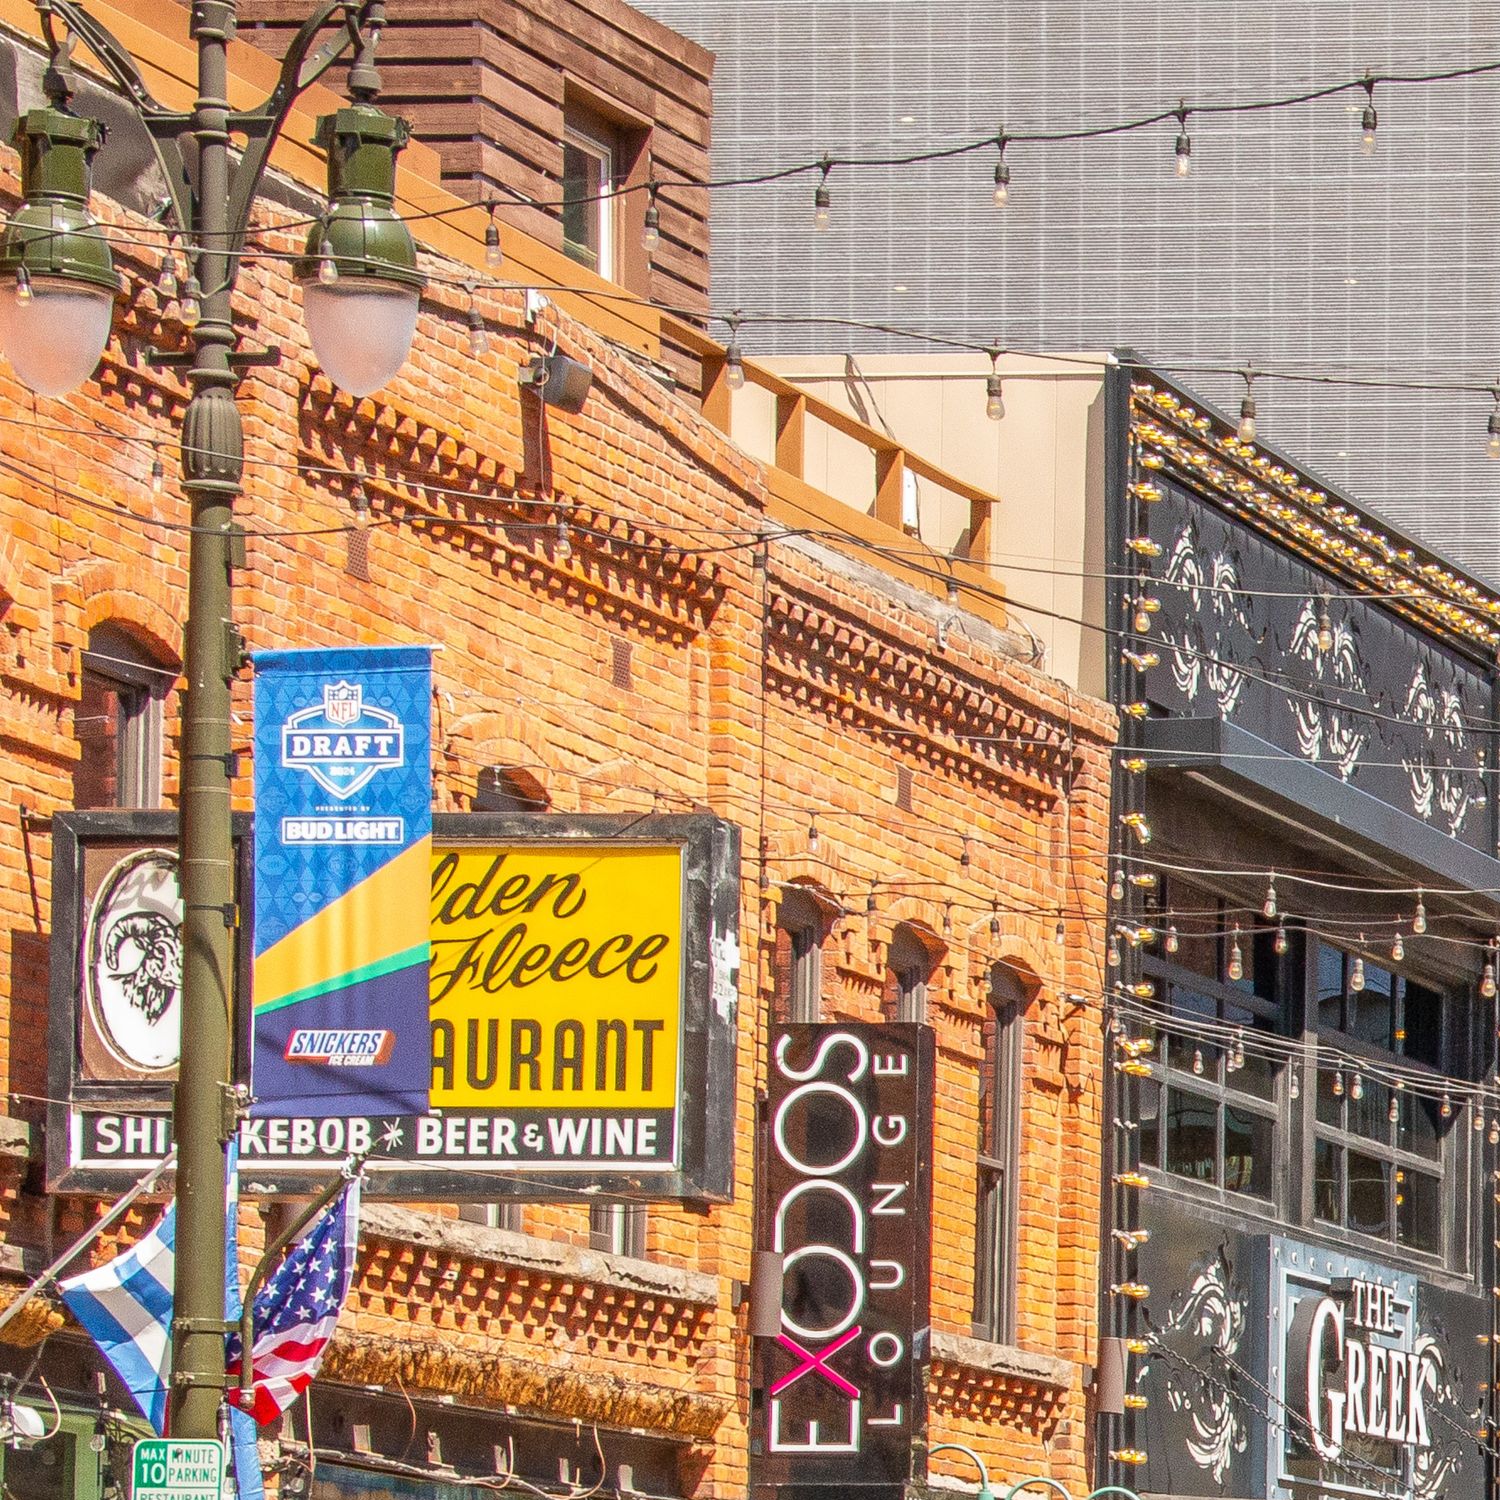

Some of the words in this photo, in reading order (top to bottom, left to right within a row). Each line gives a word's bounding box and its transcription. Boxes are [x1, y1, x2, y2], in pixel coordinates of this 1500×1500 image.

[331, 702, 356, 721] NFL
[292, 735, 393, 757] DRAFT
[286, 821, 333, 840] BUD
[335, 821, 399, 840] LIGHT
[431, 852, 587, 925] lden
[431, 922, 670, 1006] Fleece
[292, 1032, 382, 1054] SNICKERS
[328, 1055, 343, 1066] ICE
[344, 1055, 376, 1066] CREAM
[431, 1017, 665, 1092] AURANT
[96, 1116, 177, 1154] SHI
[241, 1117, 372, 1155] KEBOB
[417, 1116, 518, 1156] BEER
[547, 1116, 657, 1156] WINE
[769, 1031, 869, 1454] EXODOS
[867, 1053, 909, 1426] LOUNGE
[1352, 1278, 1395, 1334] THE
[1307, 1297, 1432, 1460] GREEK
[140, 1447, 166, 1461] MAX
[171, 1449, 214, 1464] MINUTE
[142, 1462, 166, 1484] 10
[168, 1467, 217, 1483] PARKING
